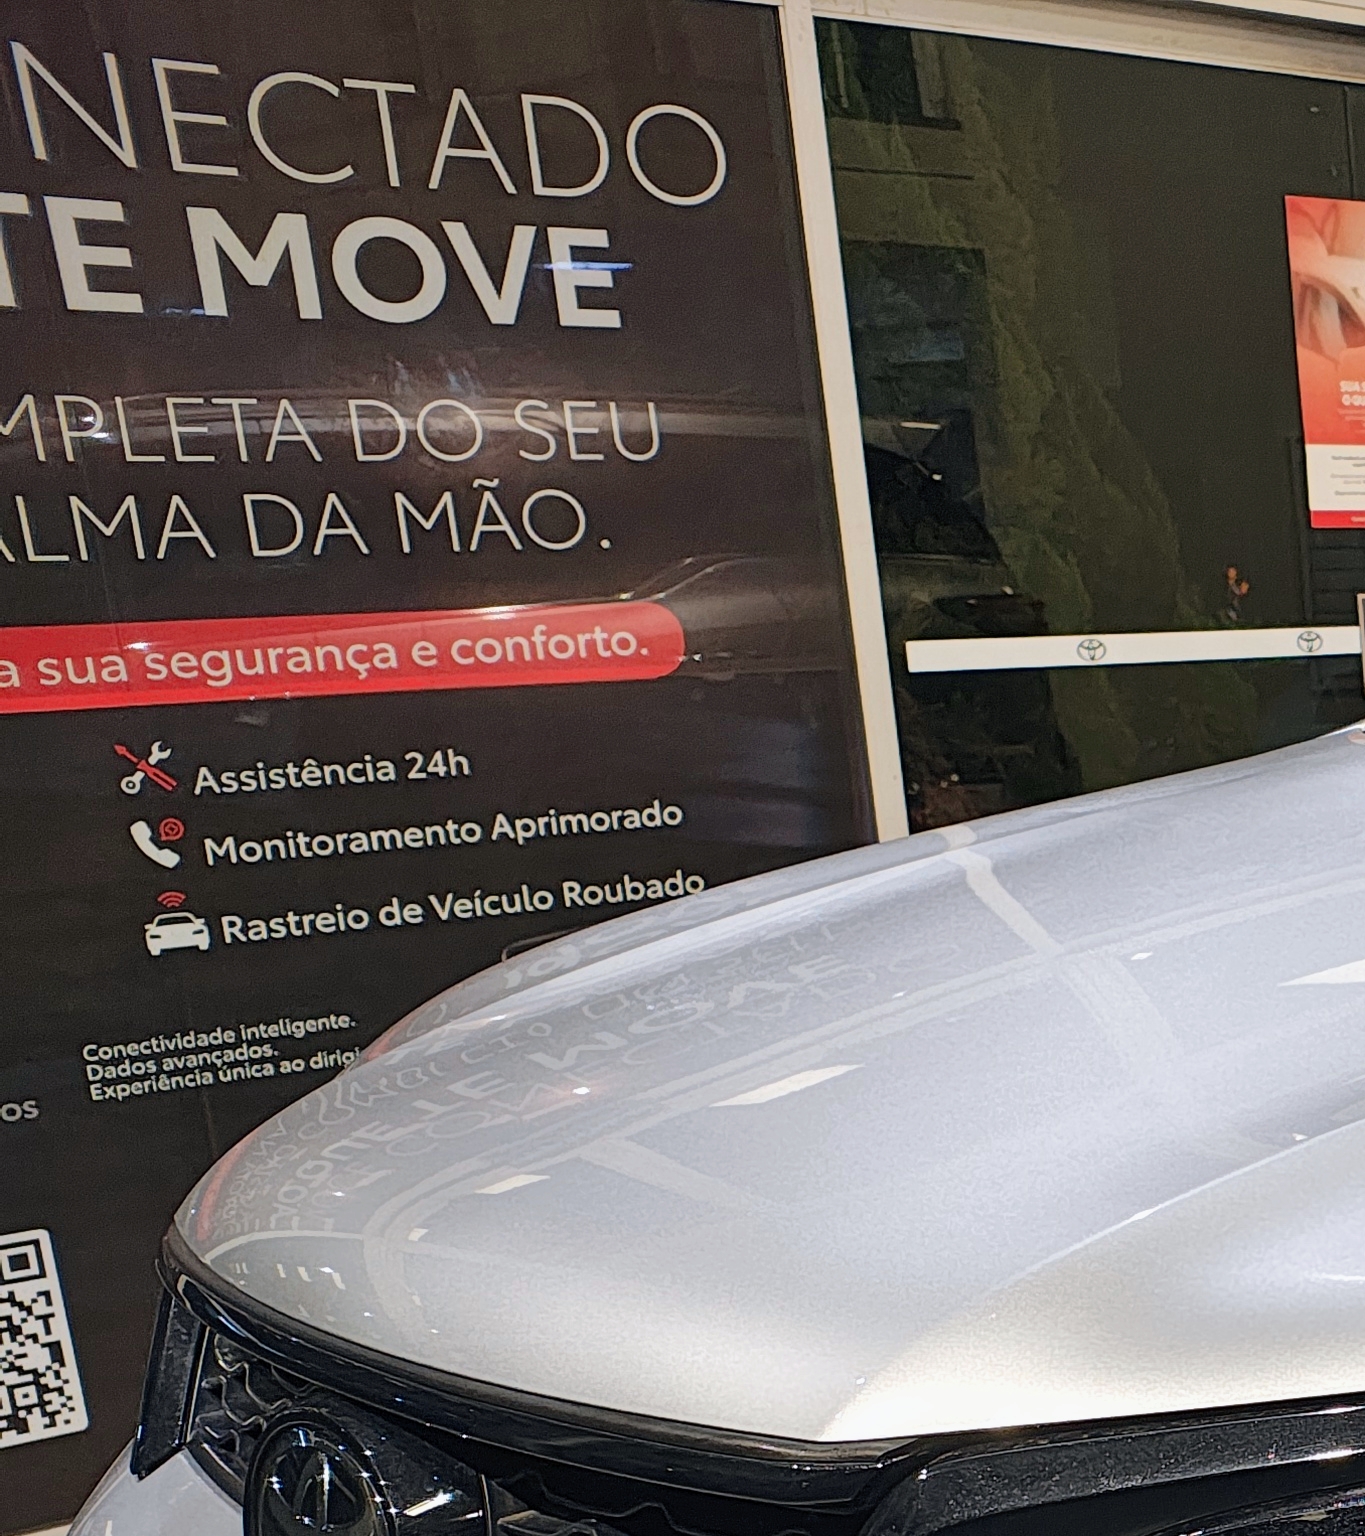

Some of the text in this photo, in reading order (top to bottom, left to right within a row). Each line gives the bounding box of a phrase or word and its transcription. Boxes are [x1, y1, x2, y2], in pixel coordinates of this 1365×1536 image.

[9, 41, 727, 207] NECTADO
[186, 206, 623, 329] MOVE
[350, 400, 484, 462] DO
[515, 401, 661, 462] SEU
[0, 478, 611, 562] LMA DA MÃO.
[38, 655, 128, 686] sua
[145, 642, 398, 689] segurança
[411, 640, 438, 667] e
[450, 622, 651, 665] conforto.
[194, 748, 470, 795] Assistência 24h
[204, 799, 683, 866] Monitoramento Aprimorado
[221, 868, 705, 944] Rastreio de Veículo Roubado
[82, 1013, 357, 1063] Conectividade inteligente.
[85, 1042, 279, 1083] Dados avançados.
[90, 1068, 213, 1102] Experiência
[218, 1056, 275, 1082] única
[279, 1058, 305, 1075] ao
